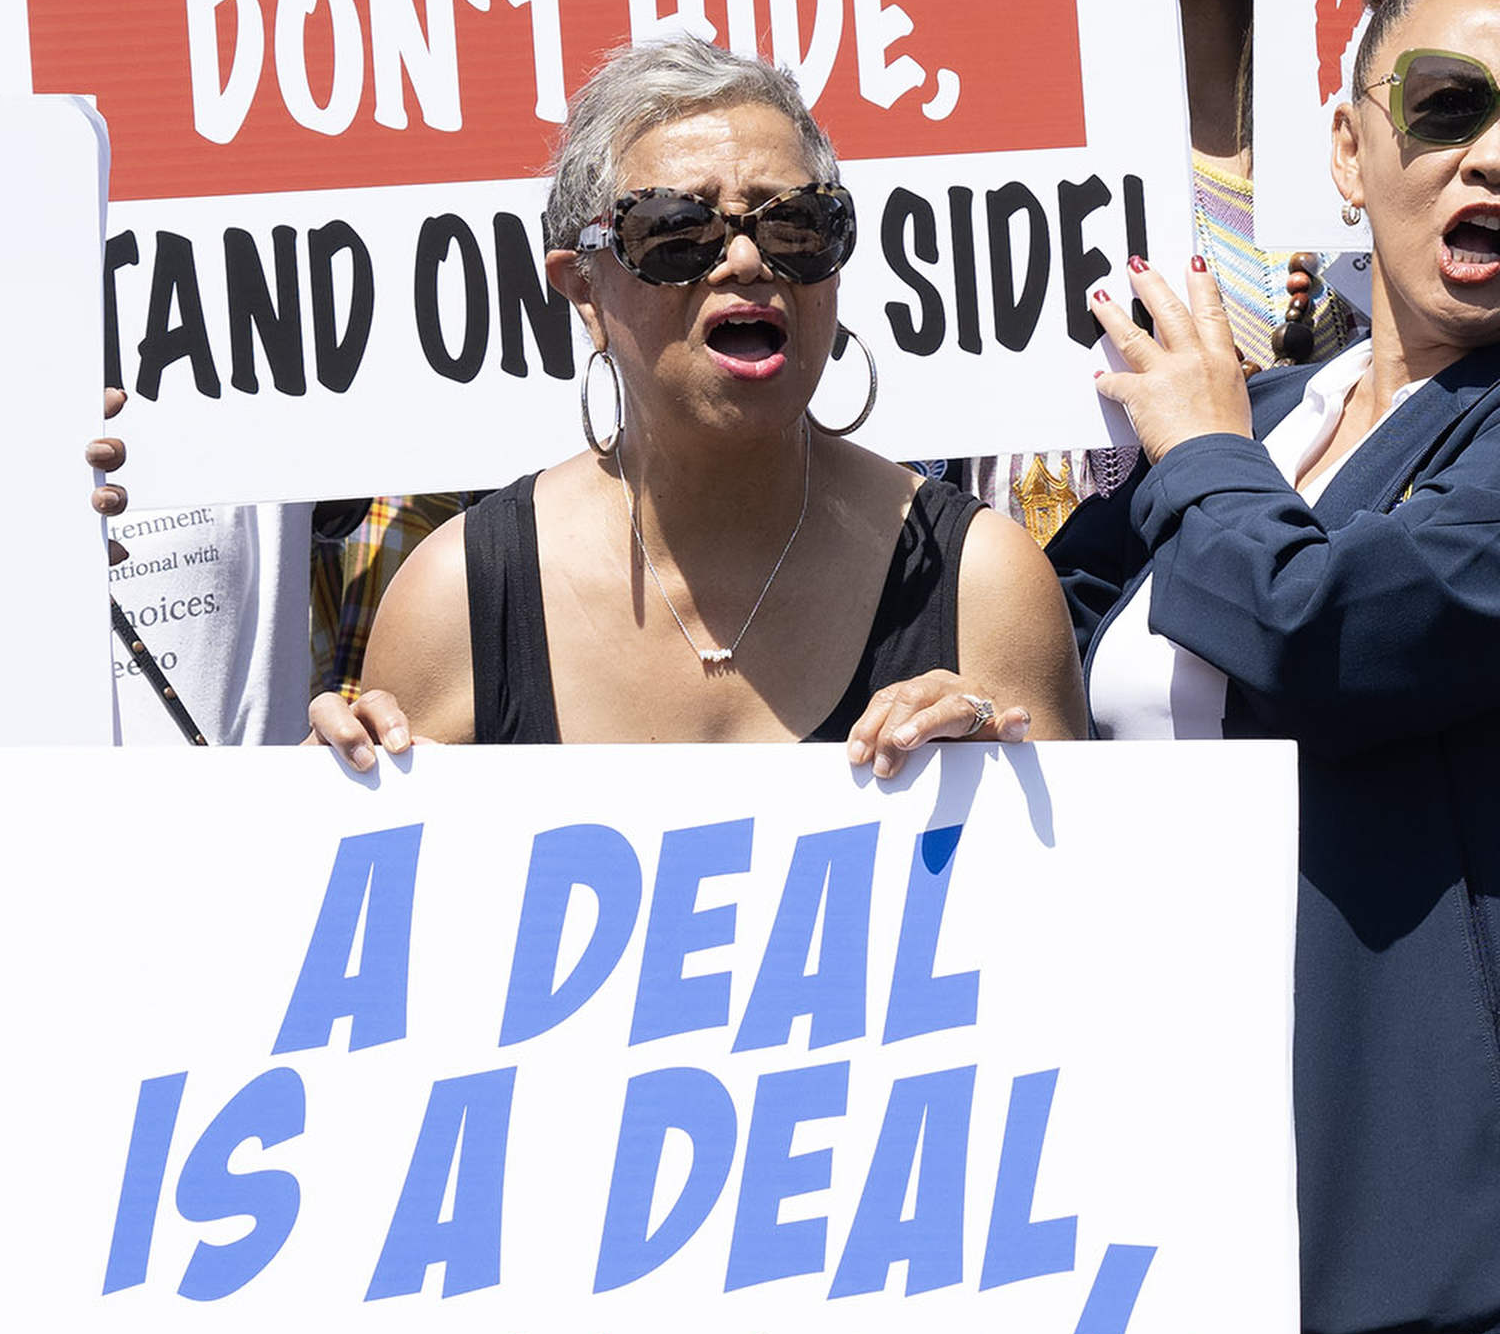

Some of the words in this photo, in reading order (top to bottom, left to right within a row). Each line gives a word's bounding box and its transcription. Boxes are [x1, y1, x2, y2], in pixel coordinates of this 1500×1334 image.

[881, 174, 1154, 357] SIDE!
[184, 545, 220, 566] with
[271, 823, 424, 1055] A
[498, 817, 980, 1053] DEAL
[102, 1067, 306, 1301] IS
[364, 1067, 517, 1302] A
